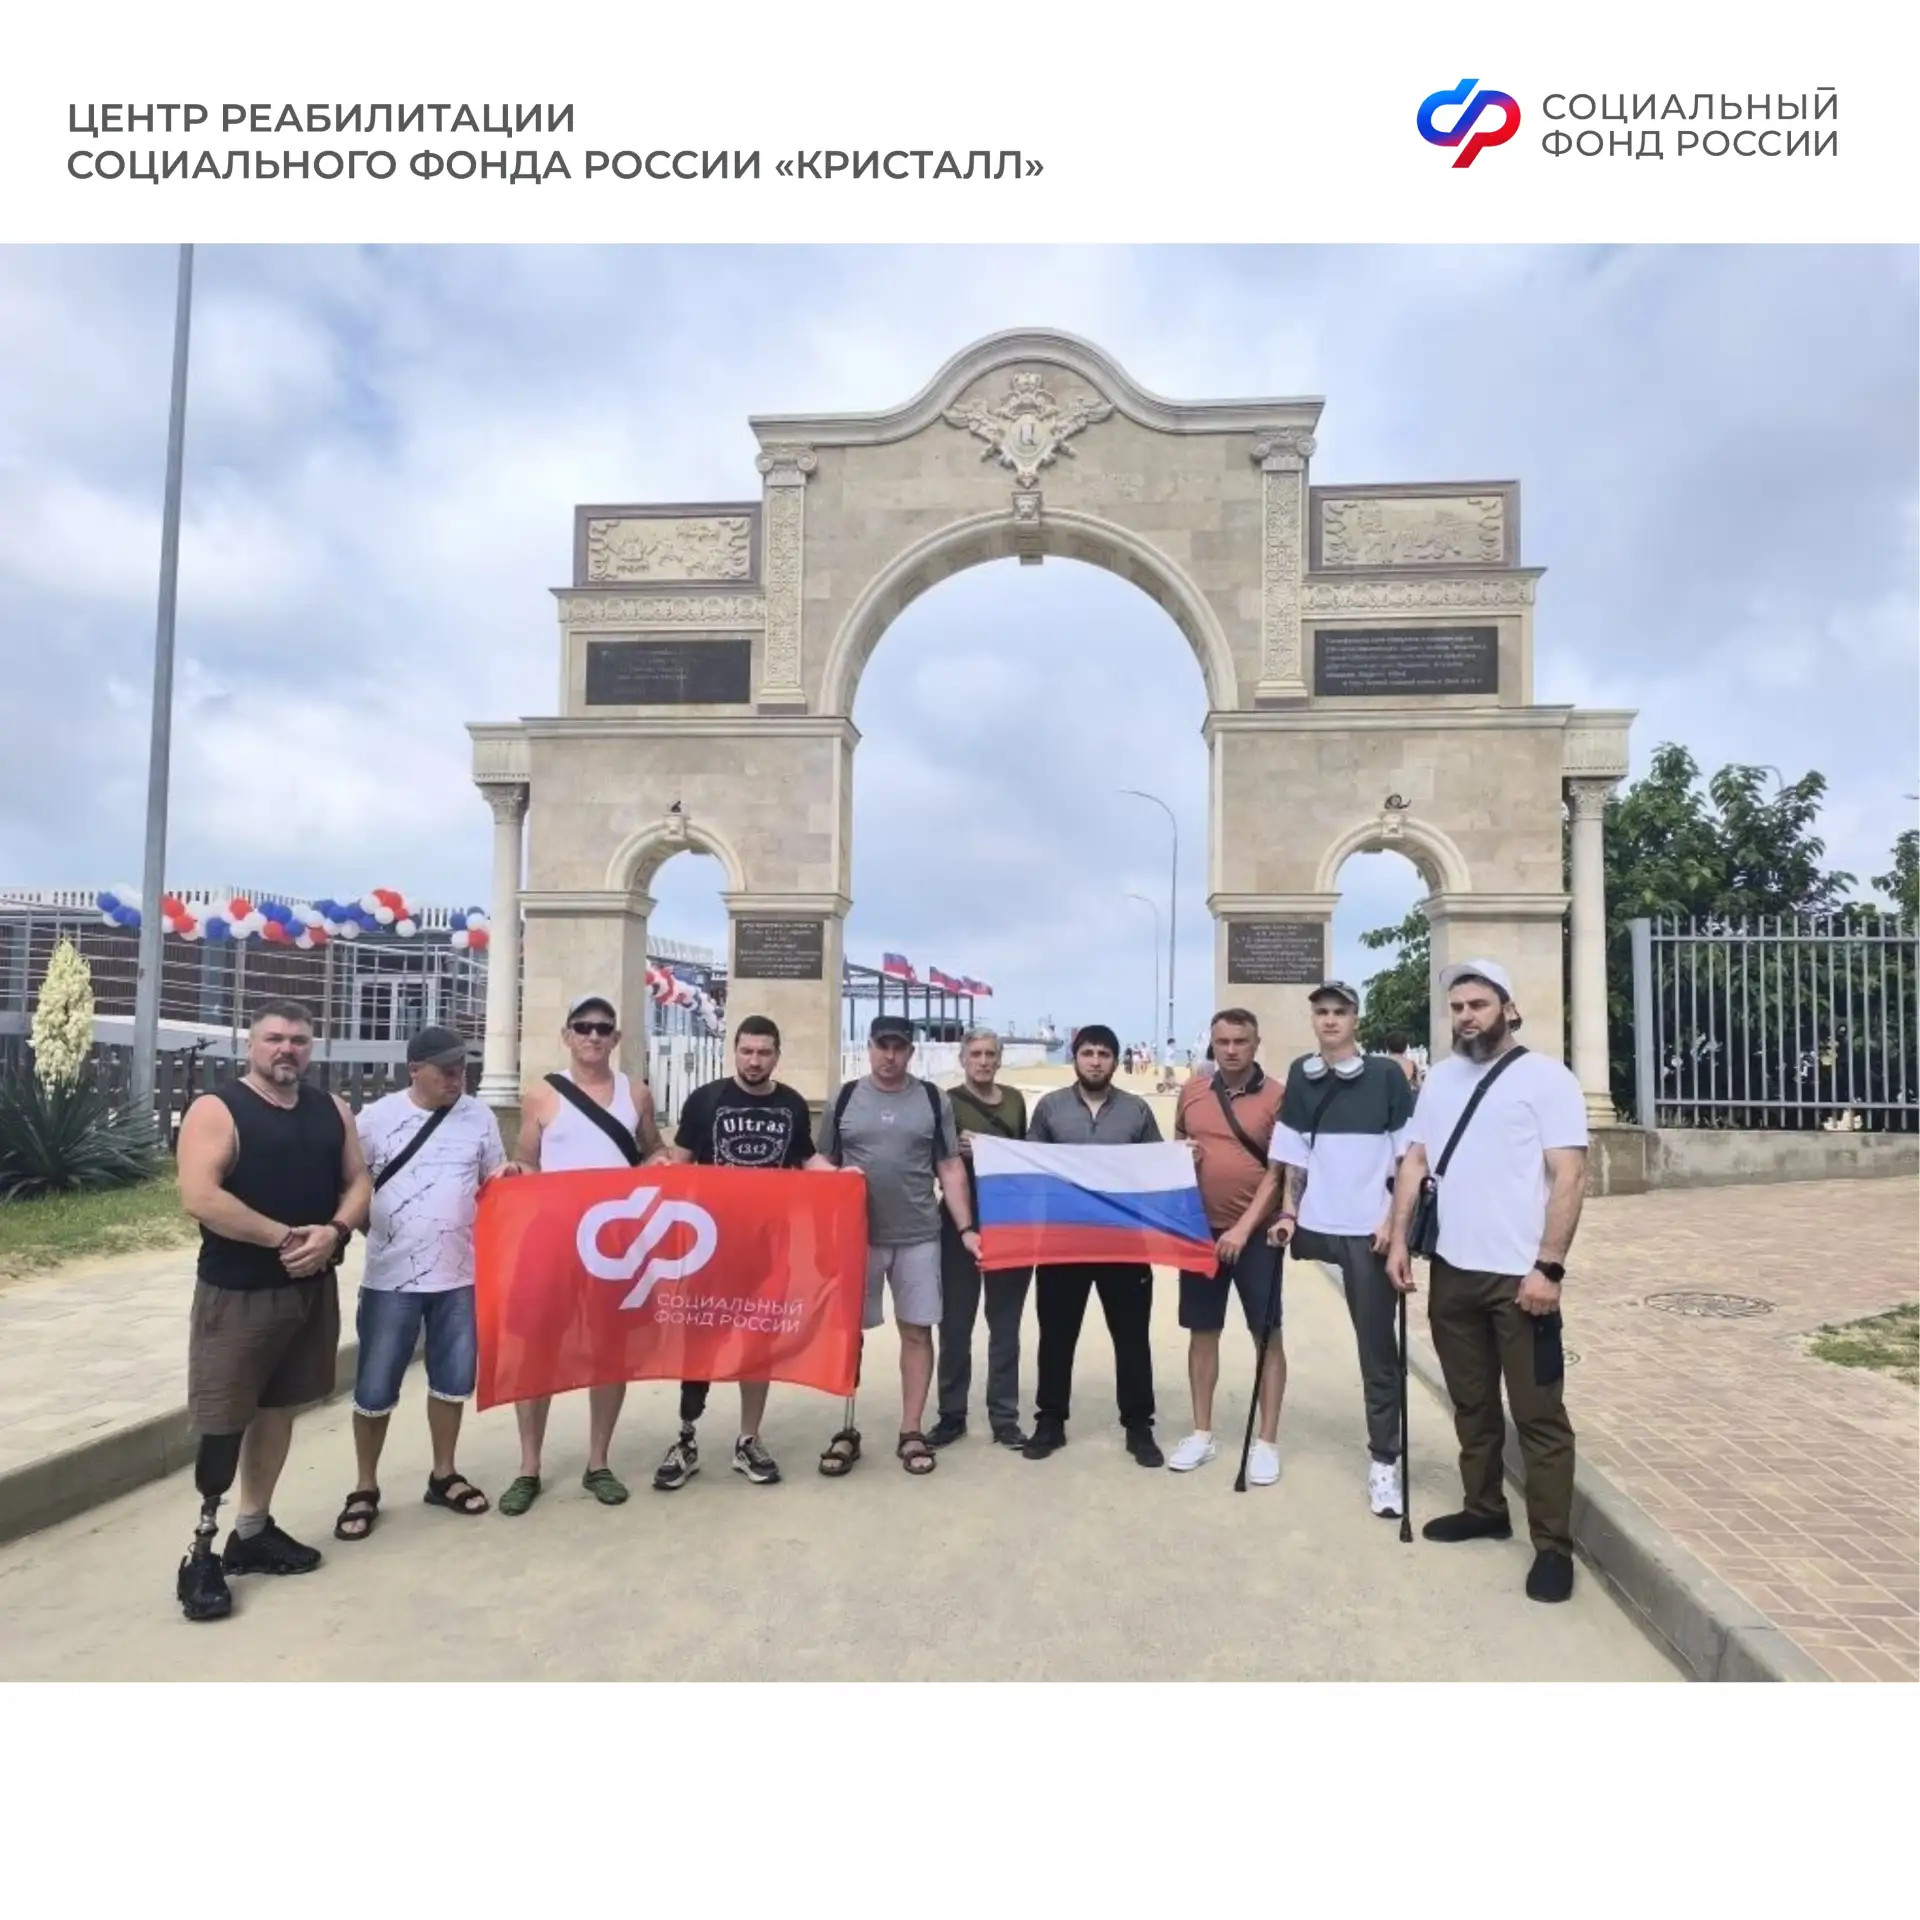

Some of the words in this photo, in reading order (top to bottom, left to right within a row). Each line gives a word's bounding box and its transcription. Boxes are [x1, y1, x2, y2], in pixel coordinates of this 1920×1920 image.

[723, 1117, 786, 1134] Ultras
[656, 1293, 804, 1316] СОЦИАЛЬНЫЙ
[653, 1308, 716, 1327] ФОНД
[719, 1313, 801, 1334] РОССИИ
